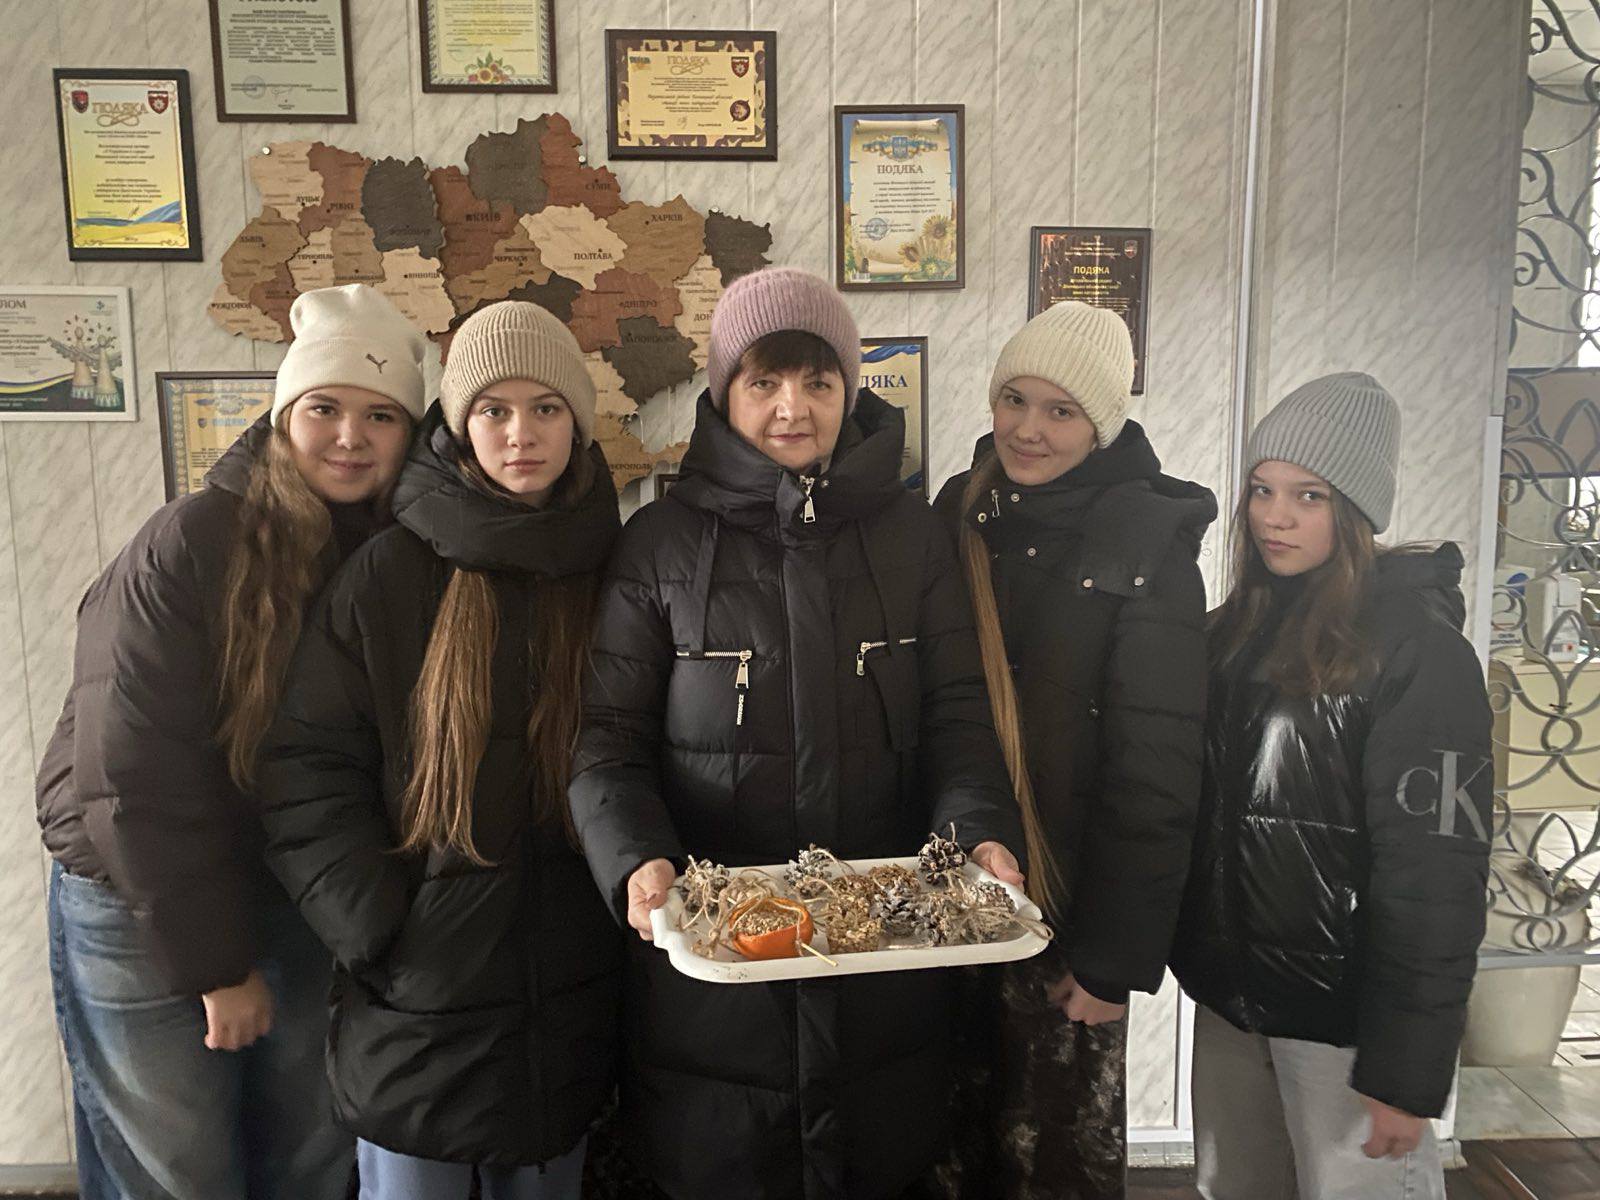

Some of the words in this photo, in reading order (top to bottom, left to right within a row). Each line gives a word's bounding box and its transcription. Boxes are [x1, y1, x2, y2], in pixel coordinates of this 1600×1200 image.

[667, 55, 711, 66] ПОДЯКА
[92, 101, 149, 114] ПОДЯКА
[876, 164, 924, 175] ПОДЯКА
[650, 213, 683, 222] ХАРКІВ
[574, 252, 613, 261] ПОЛТАВА
[1073, 266, 1110, 275] ПОДЯКА
[1396, 749, 1492, 845] CK
